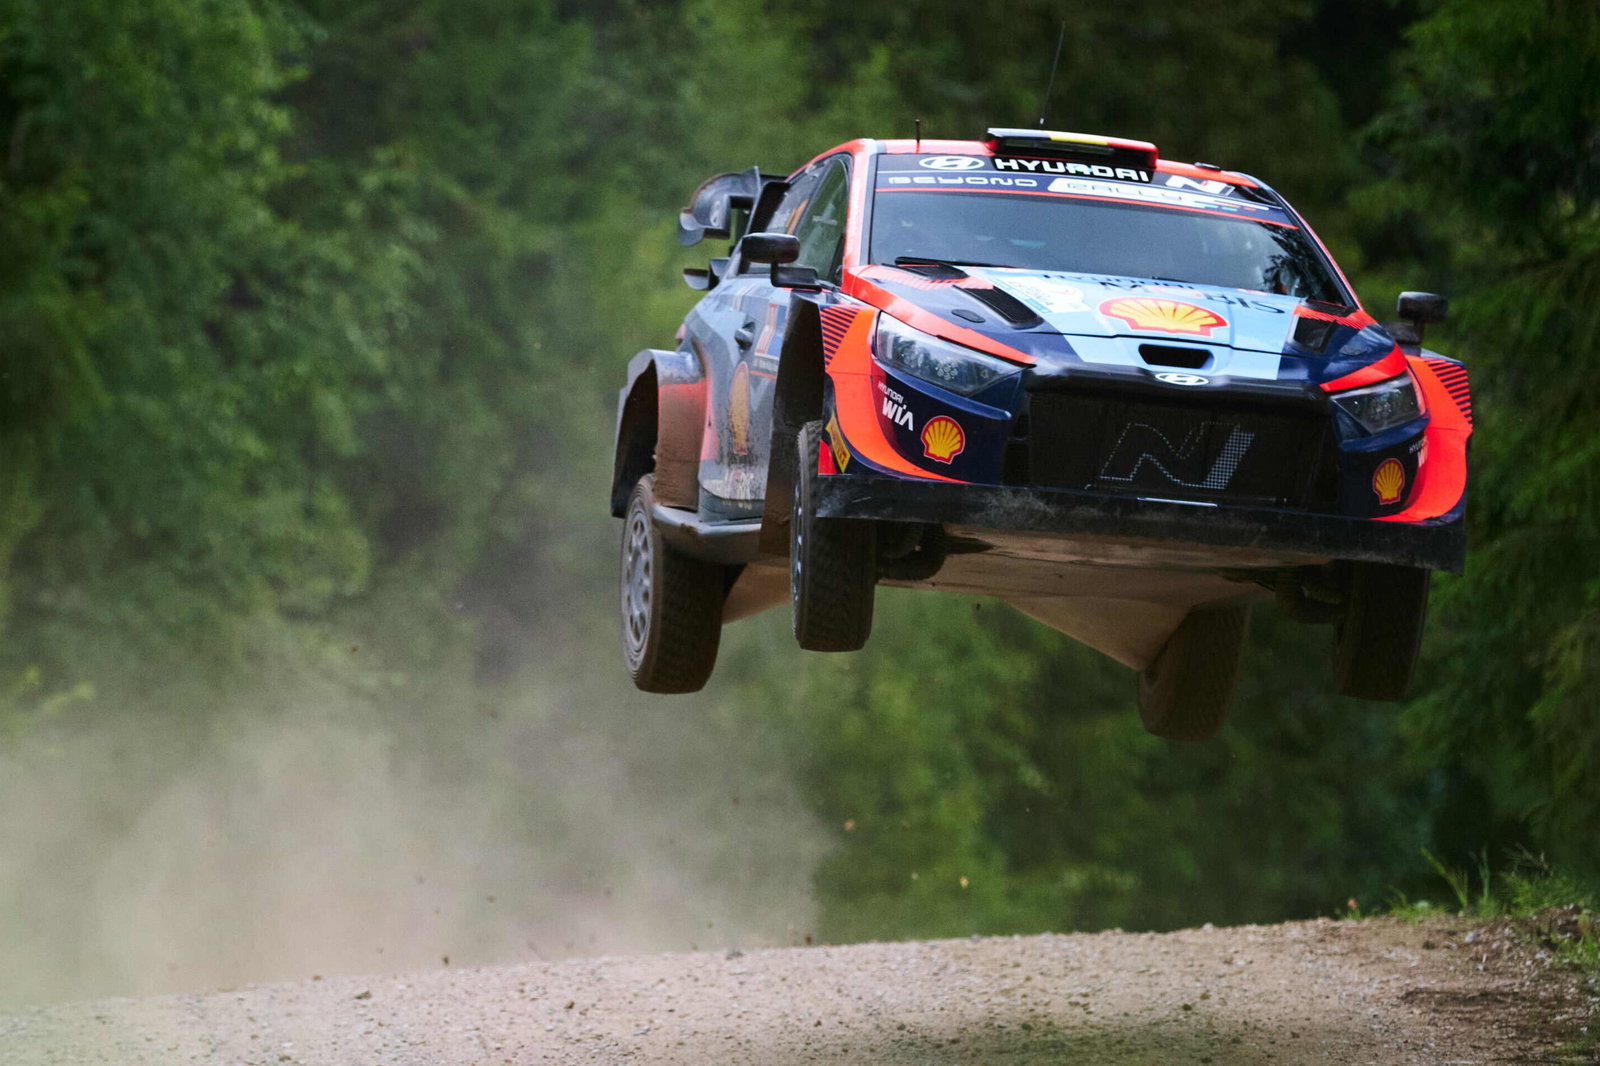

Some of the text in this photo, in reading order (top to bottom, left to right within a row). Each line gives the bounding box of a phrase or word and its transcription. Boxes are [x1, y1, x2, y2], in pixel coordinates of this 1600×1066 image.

[994, 158, 1149, 181] HYUNDAI
[888, 176, 1038, 187] BEYOND
[878, 381, 904, 404] HYUNDAI
[882, 397, 914, 431] WIA
